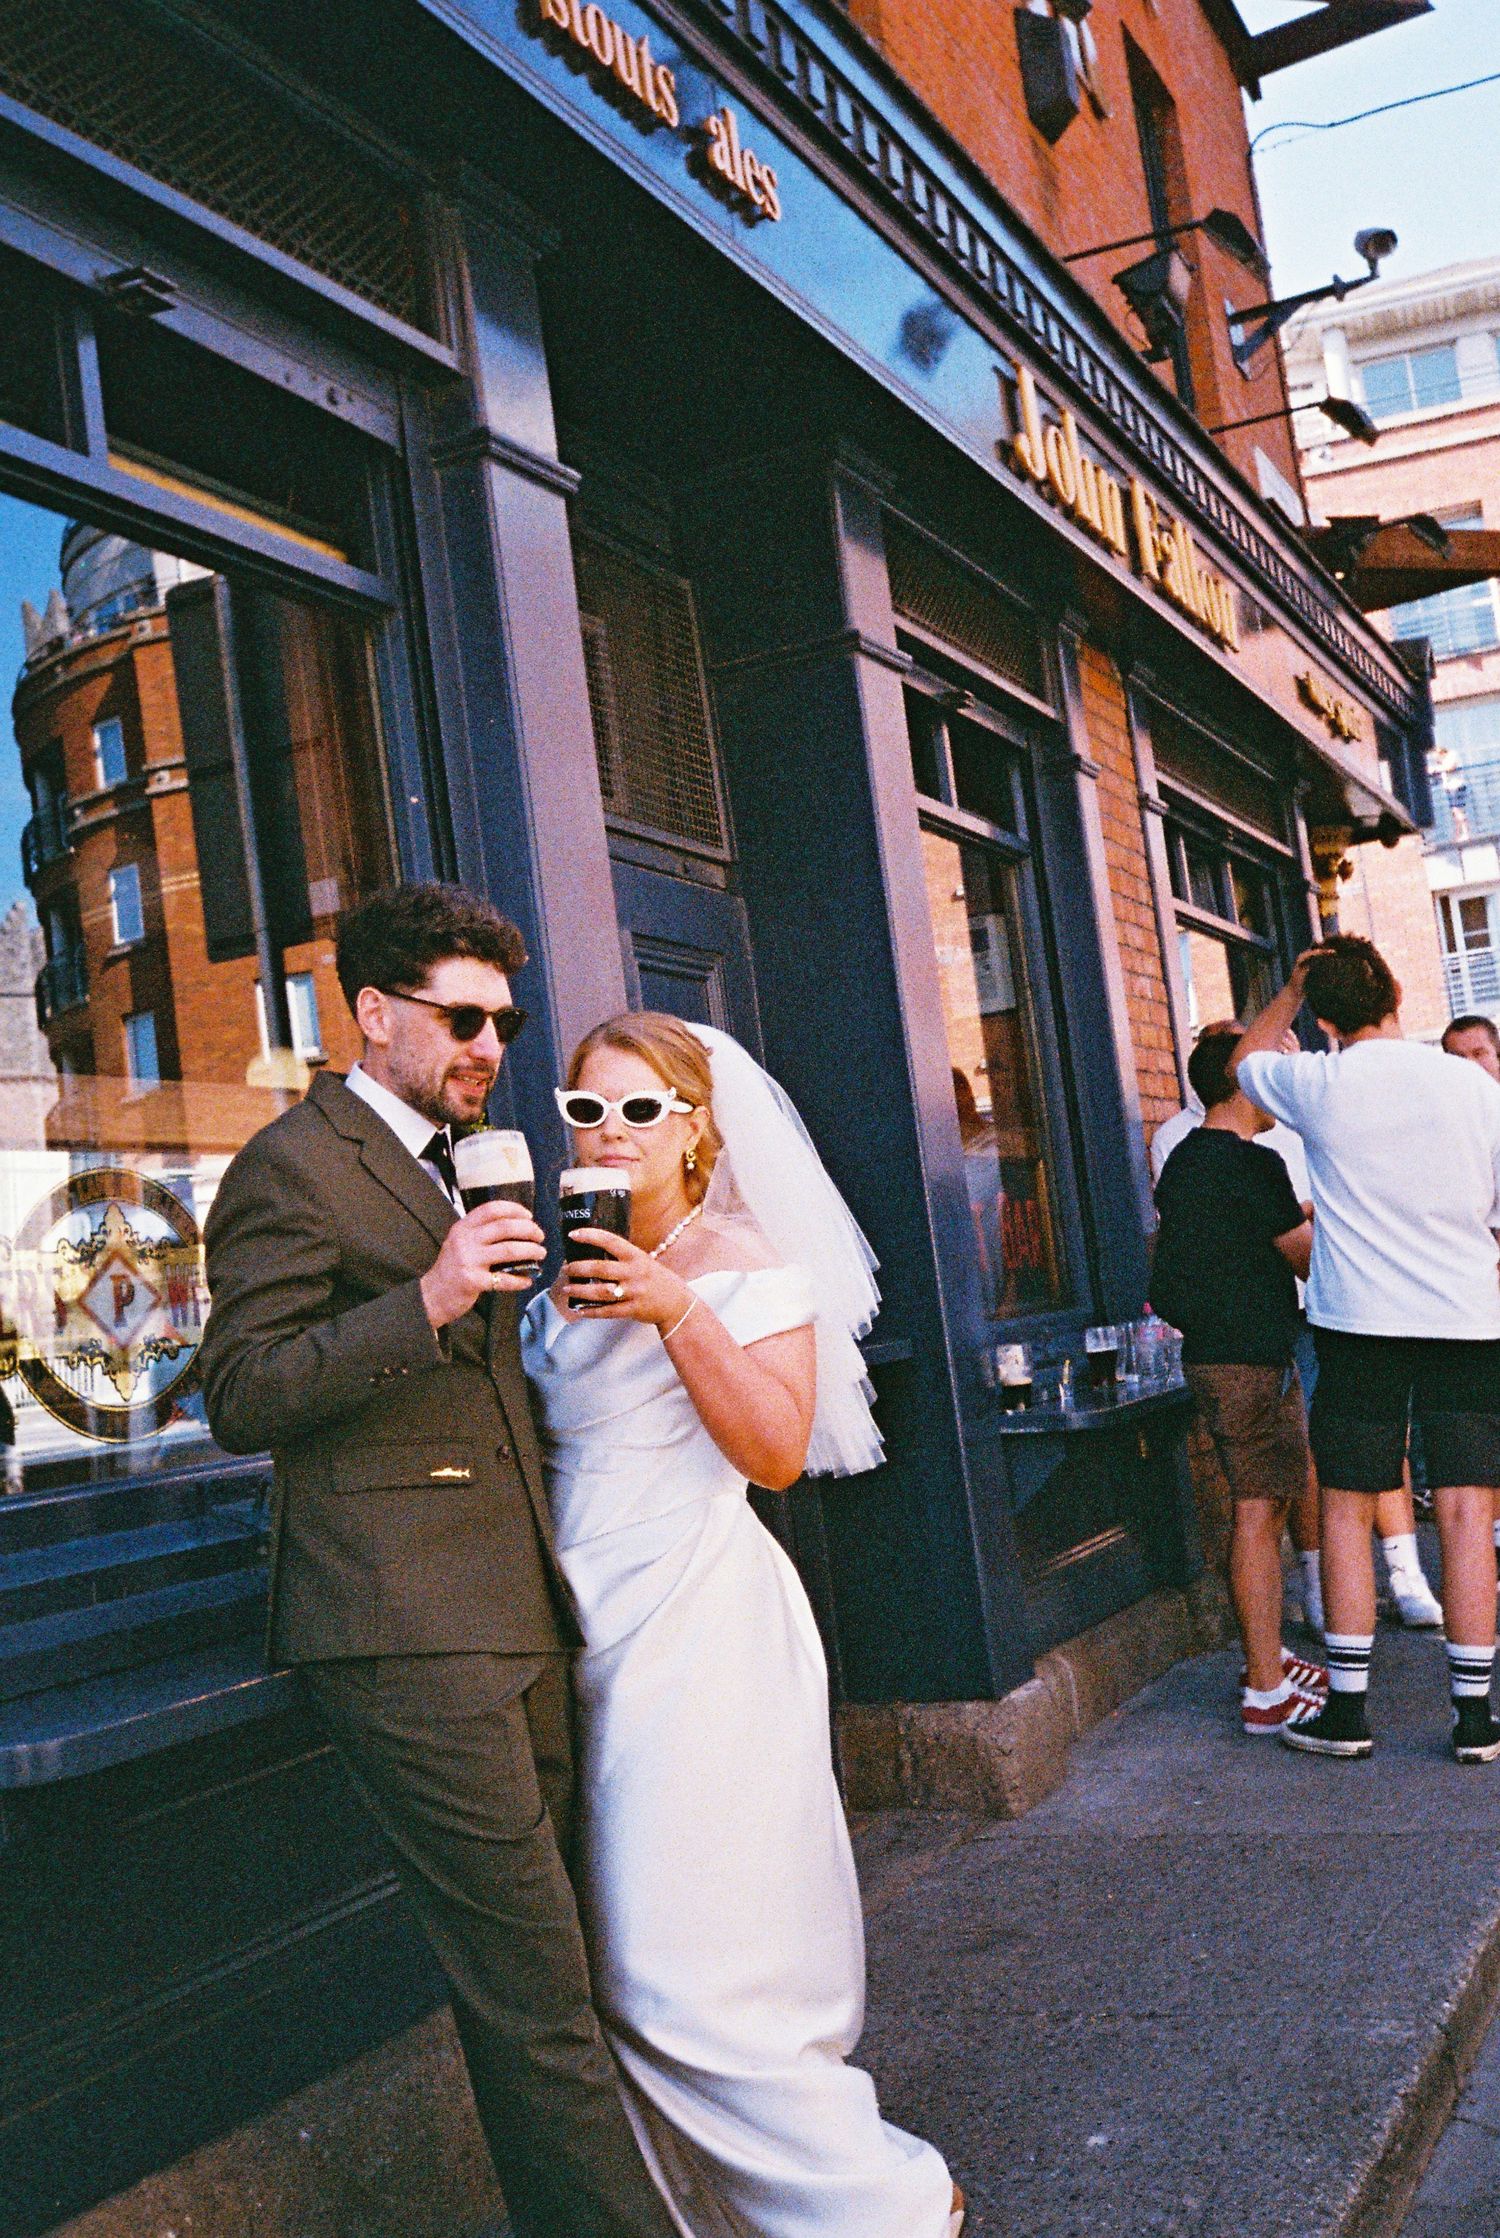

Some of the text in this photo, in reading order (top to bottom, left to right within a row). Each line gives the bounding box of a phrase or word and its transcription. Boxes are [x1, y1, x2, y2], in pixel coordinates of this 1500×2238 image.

[703, 106, 781, 222] ales
[1014, 358, 1239, 653] John Fallon
[109, 1273, 135, 1329] P
